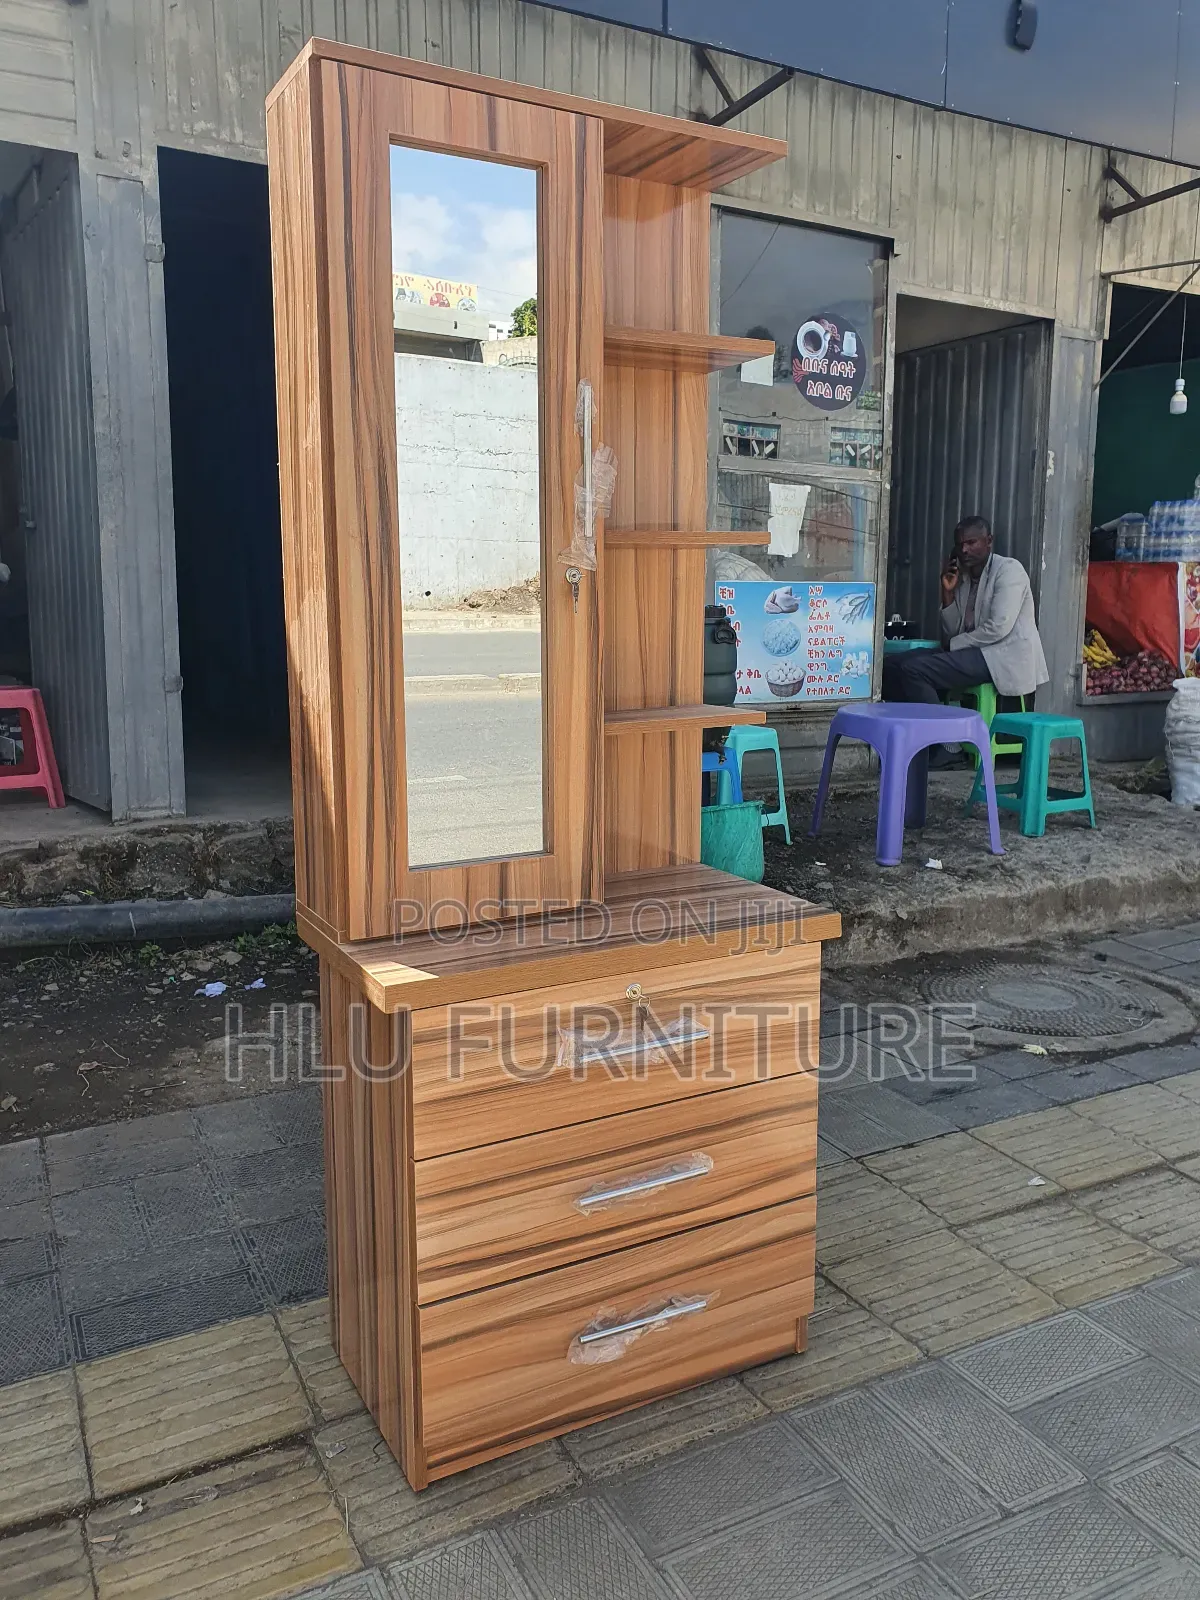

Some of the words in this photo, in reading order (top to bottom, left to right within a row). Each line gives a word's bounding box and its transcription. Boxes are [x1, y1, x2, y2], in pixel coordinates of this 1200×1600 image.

[802, 357, 828, 374] በቡና
[807, 380, 832, 399] አቦል
[835, 385, 853, 401] ቡና
